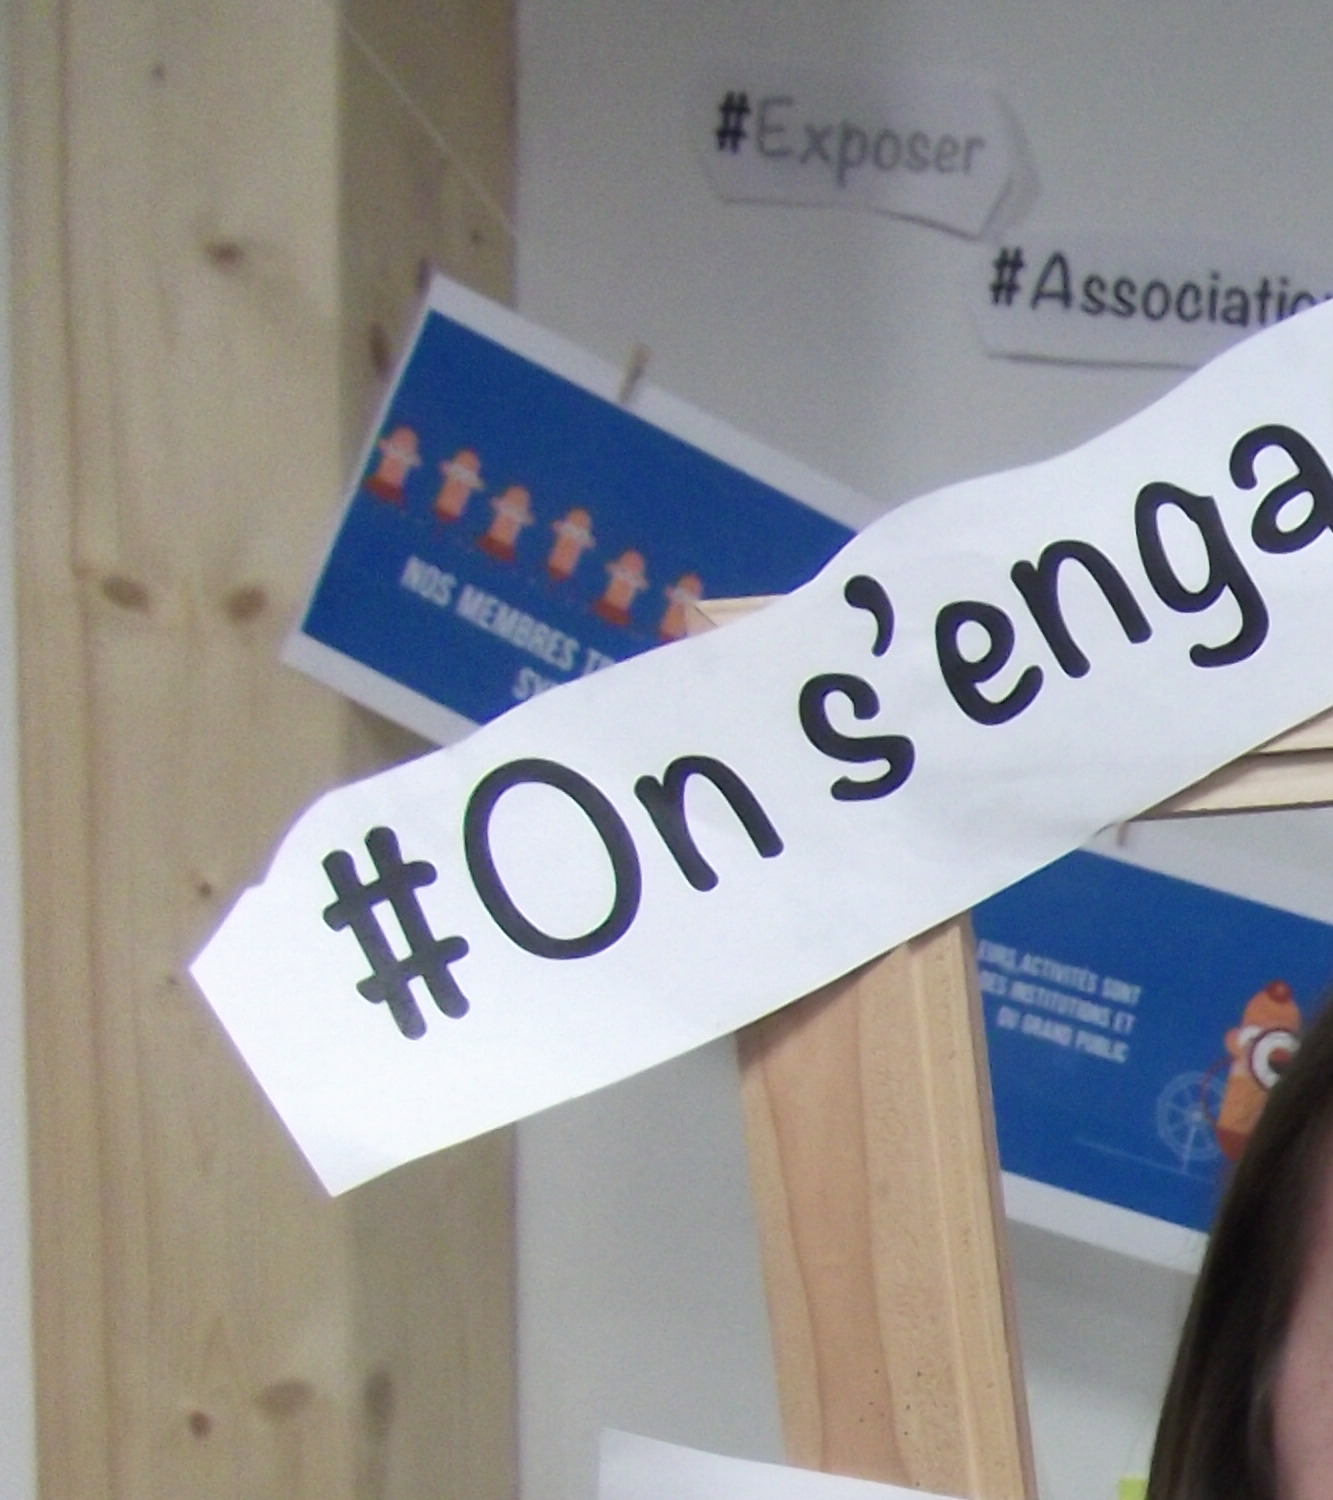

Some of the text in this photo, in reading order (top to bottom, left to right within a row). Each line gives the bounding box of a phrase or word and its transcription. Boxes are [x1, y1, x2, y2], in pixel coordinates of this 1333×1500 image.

[716, 90, 985, 188] #Exposer
[456, 582, 581, 672] MEMBRES
[321, 755, 785, 1041] #On
